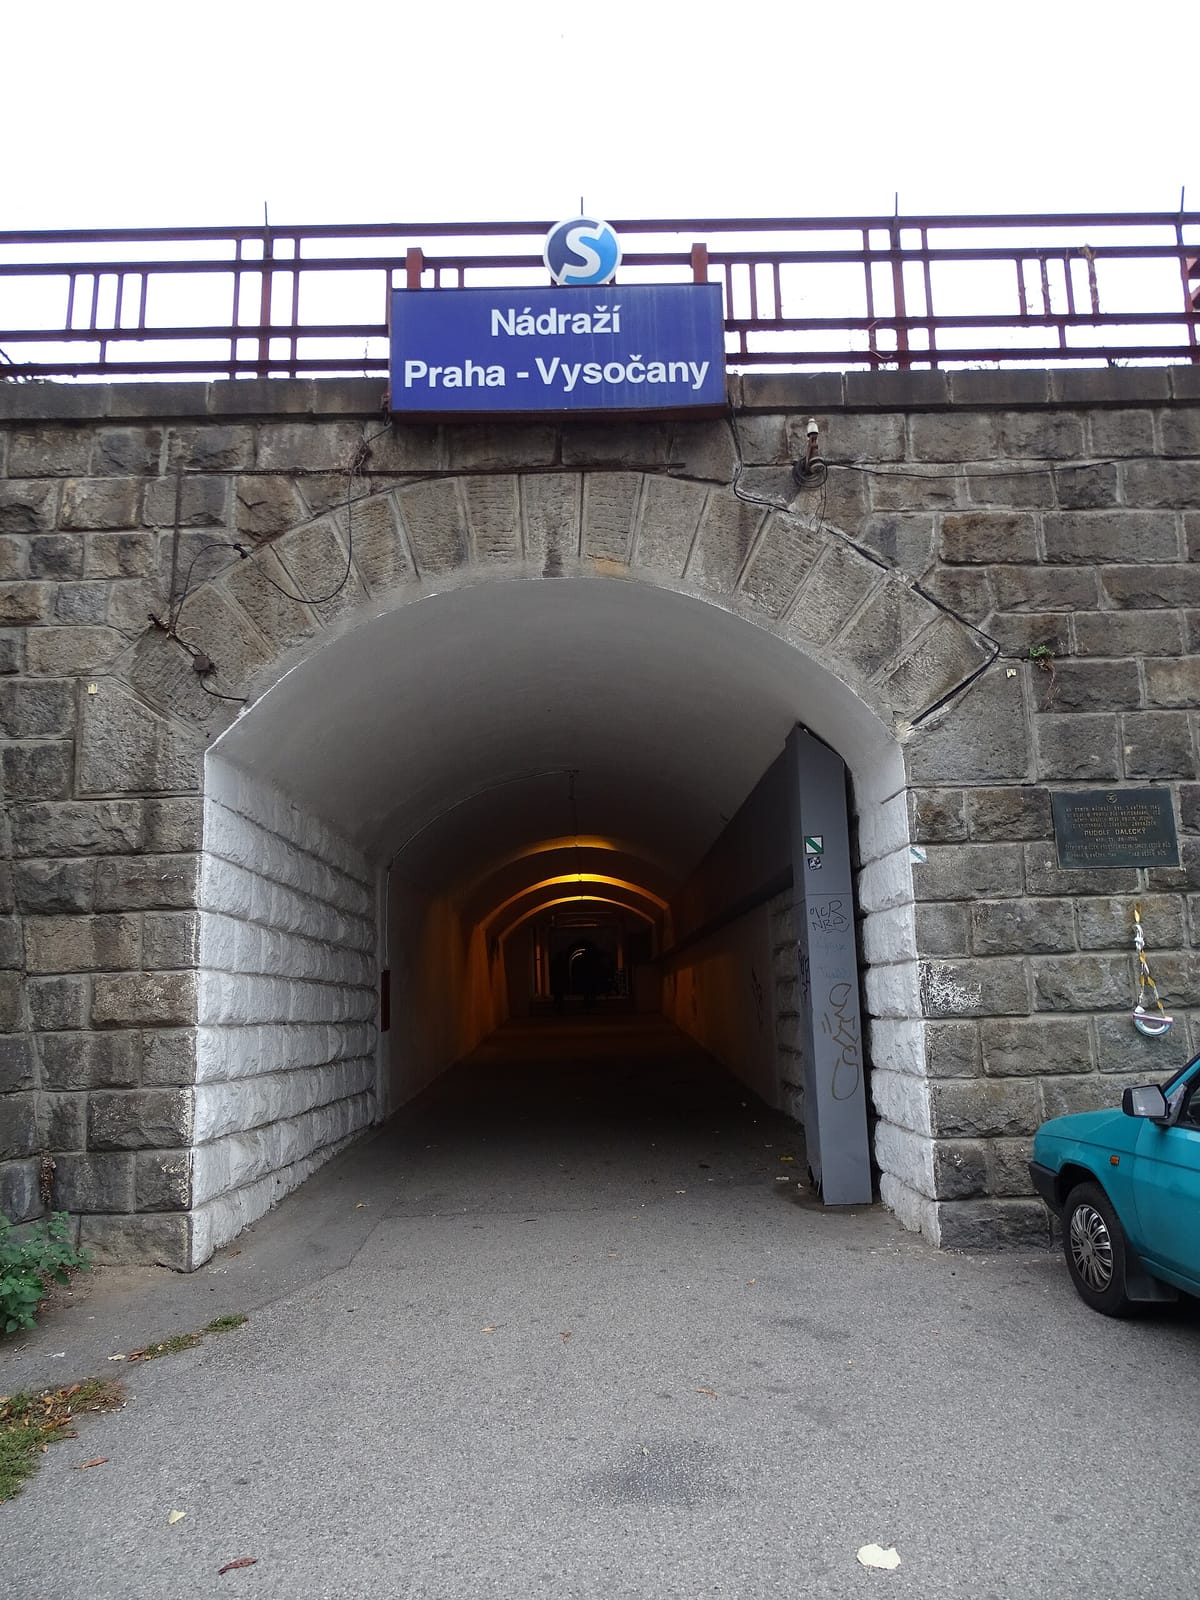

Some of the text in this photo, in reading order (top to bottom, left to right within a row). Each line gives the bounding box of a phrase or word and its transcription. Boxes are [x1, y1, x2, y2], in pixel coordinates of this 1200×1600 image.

[557, 220, 606, 284] S
[490, 304, 623, 337] Nádraží
[403, 354, 710, 392] Praha - Vysočany
